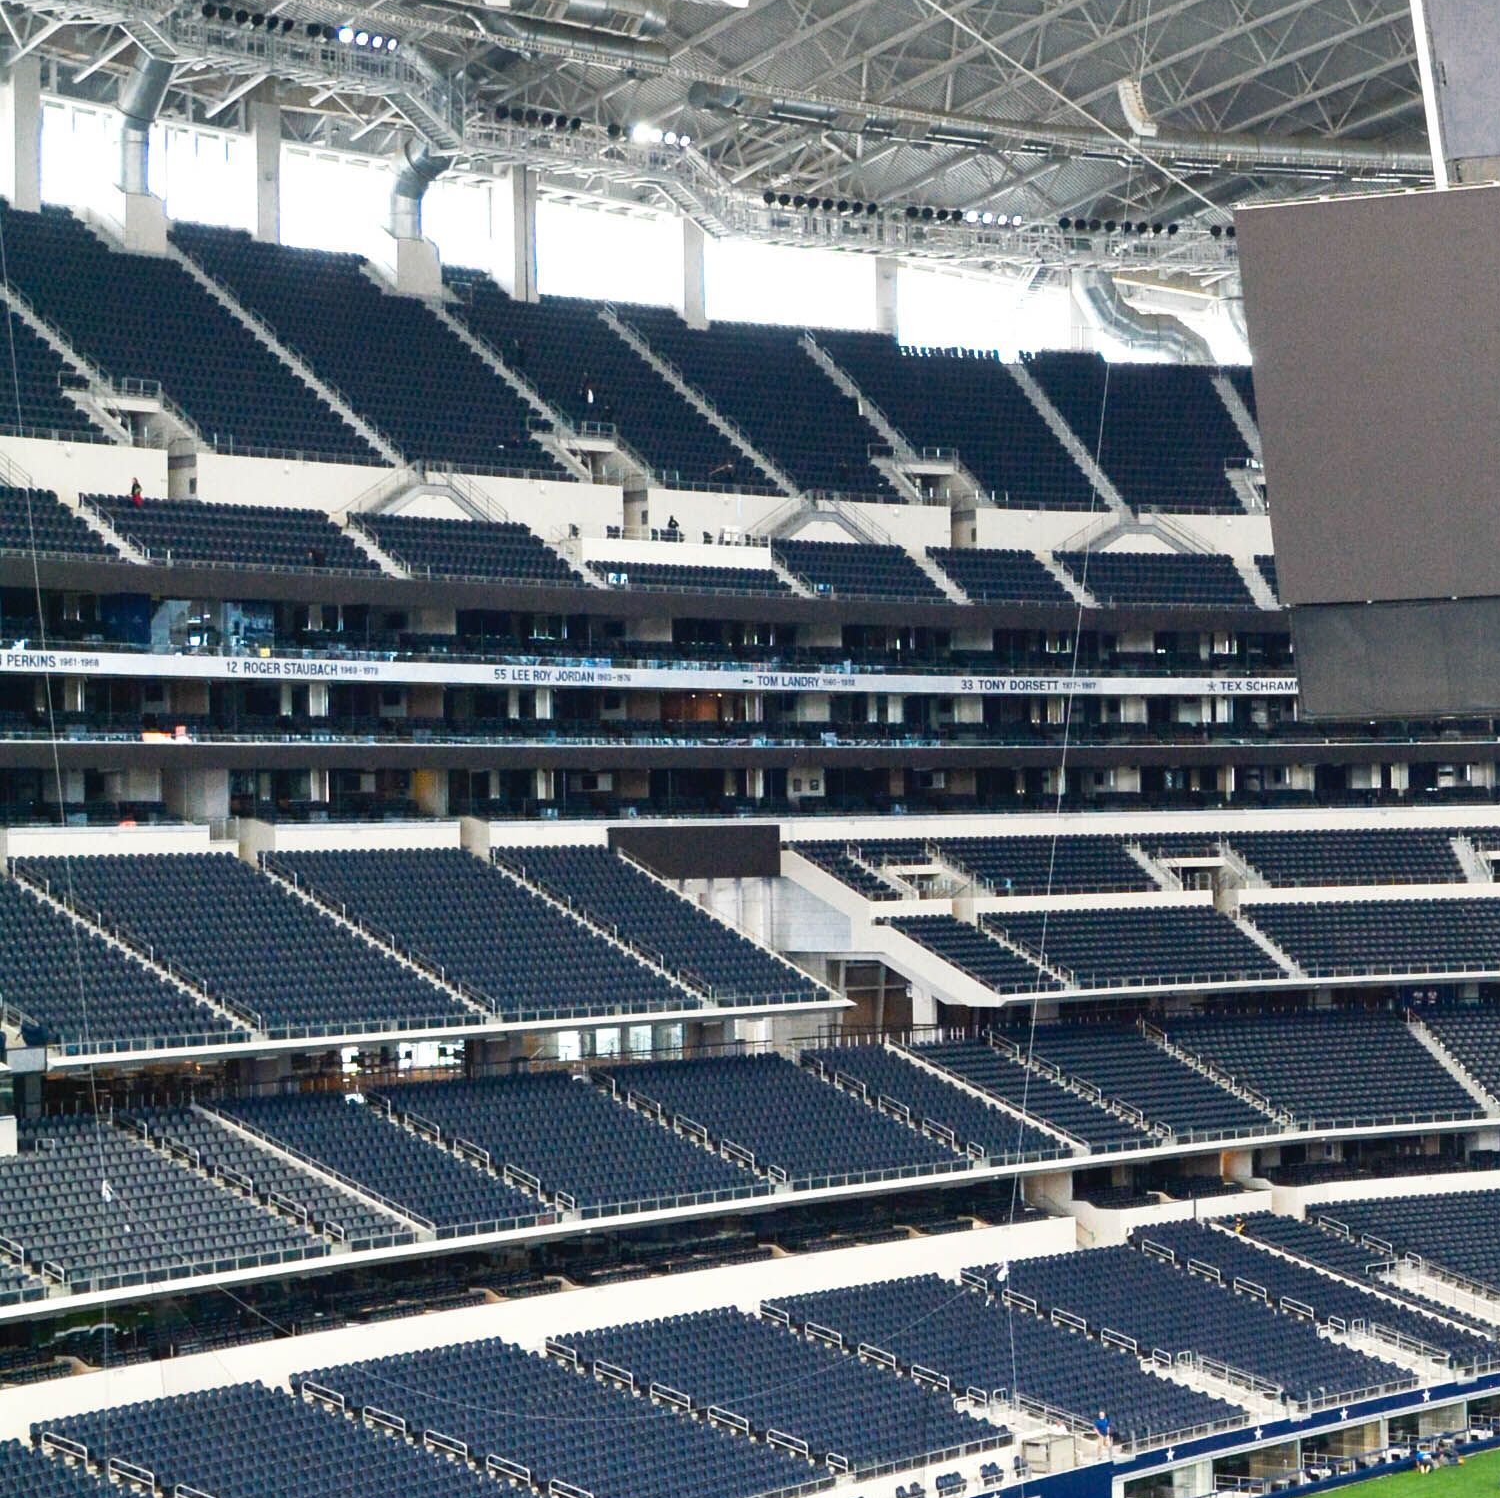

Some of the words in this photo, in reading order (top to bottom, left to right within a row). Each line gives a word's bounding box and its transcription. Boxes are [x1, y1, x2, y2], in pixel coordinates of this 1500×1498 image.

[7, 654, 56, 668] PERKINS
[226, 661, 238, 673] 12
[244, 662, 280, 674] ROGER
[284, 663, 337, 675] STAUBACH
[494, 668, 506, 680] 55
[512, 669, 530, 681] LEE
[533, 670, 551, 681] ROY
[555, 671, 594, 682] JORDAN
[757, 675, 778, 686] TOM
[782, 676, 819, 687] LANDRY
[961, 679, 973, 690] 33
[979, 680, 1006, 690] TONY
[1010, 680, 1058, 691] DORSETT
[1220, 681, 1242, 691] TEX
